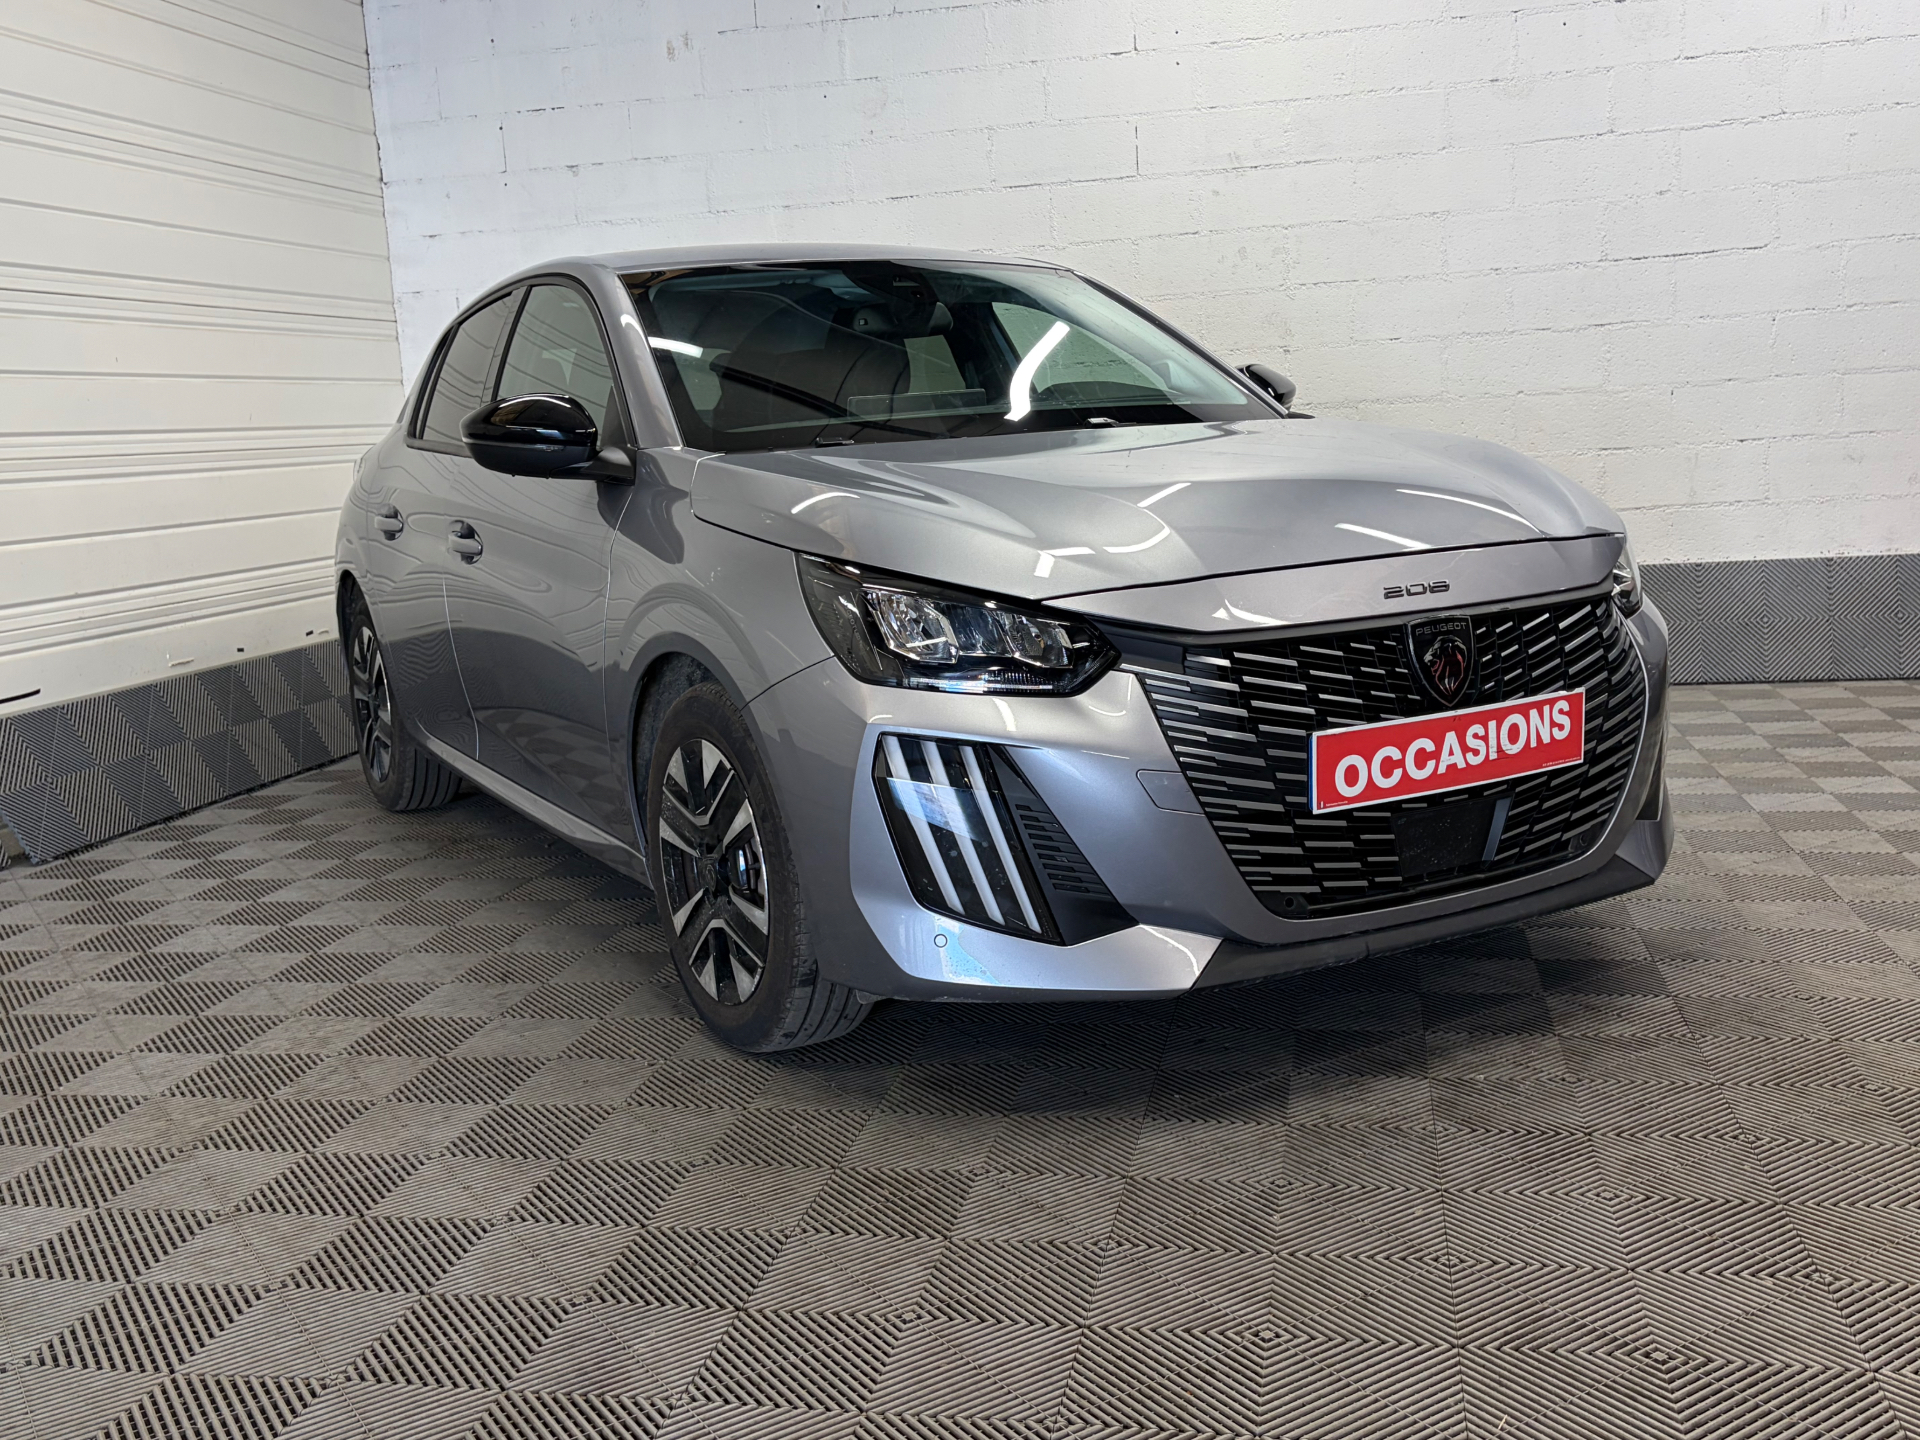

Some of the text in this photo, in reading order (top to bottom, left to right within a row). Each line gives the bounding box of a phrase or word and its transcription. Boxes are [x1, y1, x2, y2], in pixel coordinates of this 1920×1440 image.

[1383, 579, 1451, 600] 208
[1415, 622, 1467, 637] PEUGEOT
[1334, 699, 1571, 798] OCCASIONS
